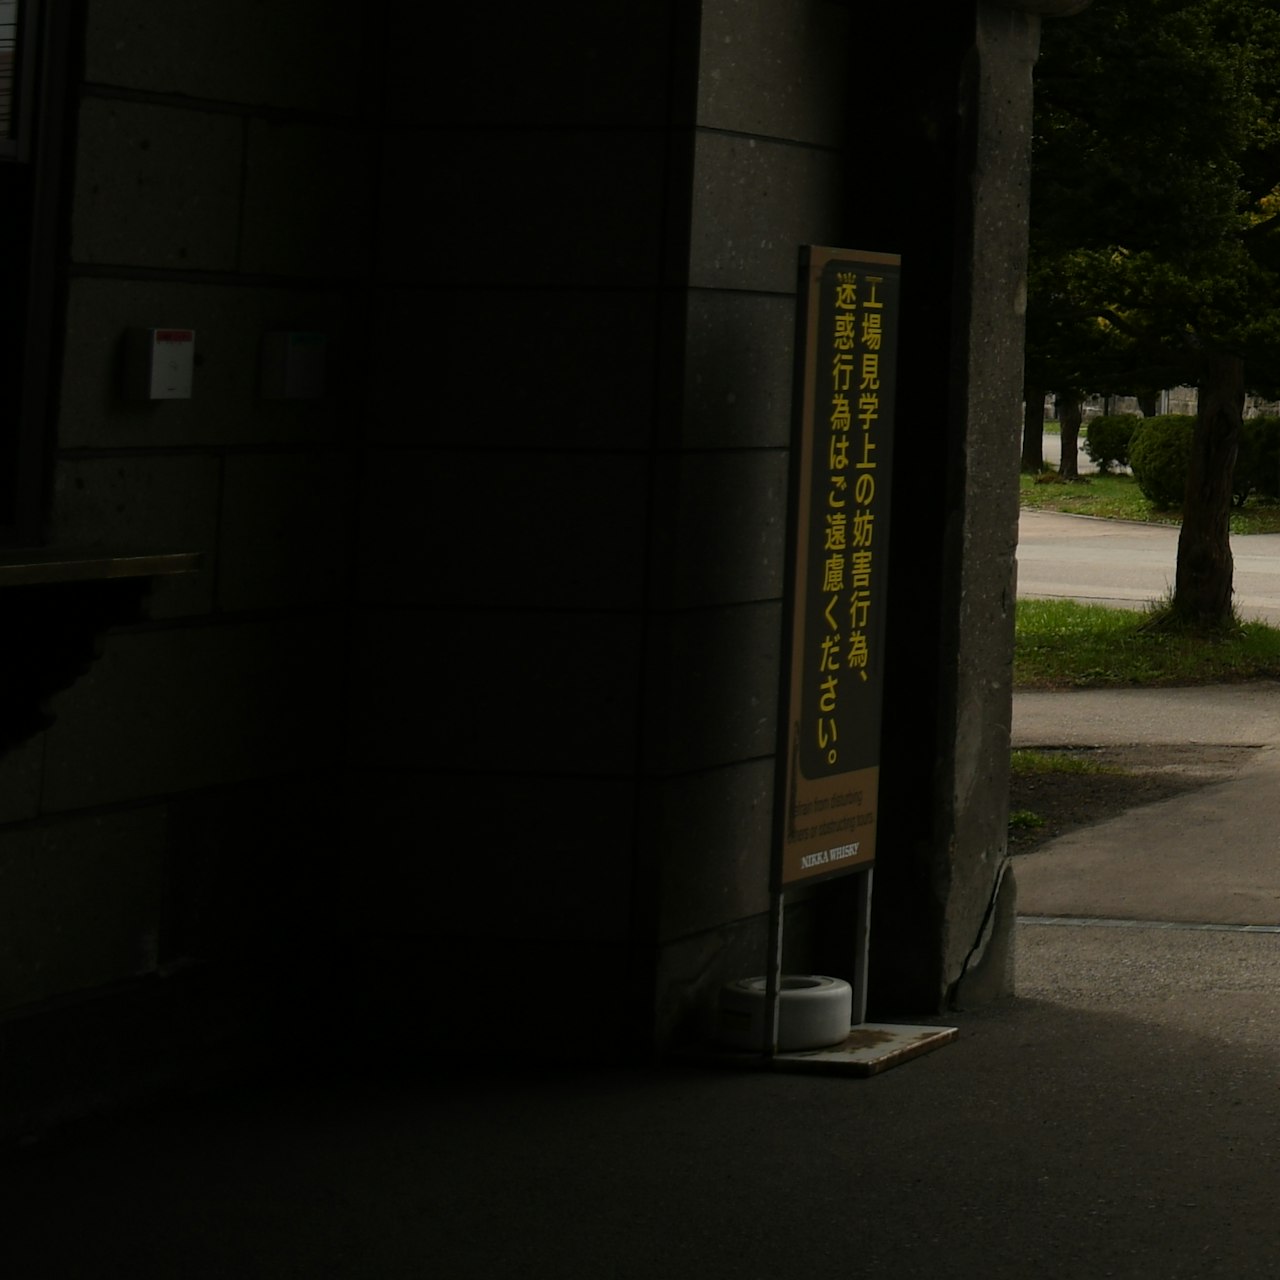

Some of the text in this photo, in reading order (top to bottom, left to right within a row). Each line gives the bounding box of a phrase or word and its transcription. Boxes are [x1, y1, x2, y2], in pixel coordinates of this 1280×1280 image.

[818, 272, 857, 765] 迷惑行為はご遠慮ください。
[847, 275, 884, 682] 工場見学上の妨害行為、
[801, 842, 860, 869] NIKKA WHISKY
